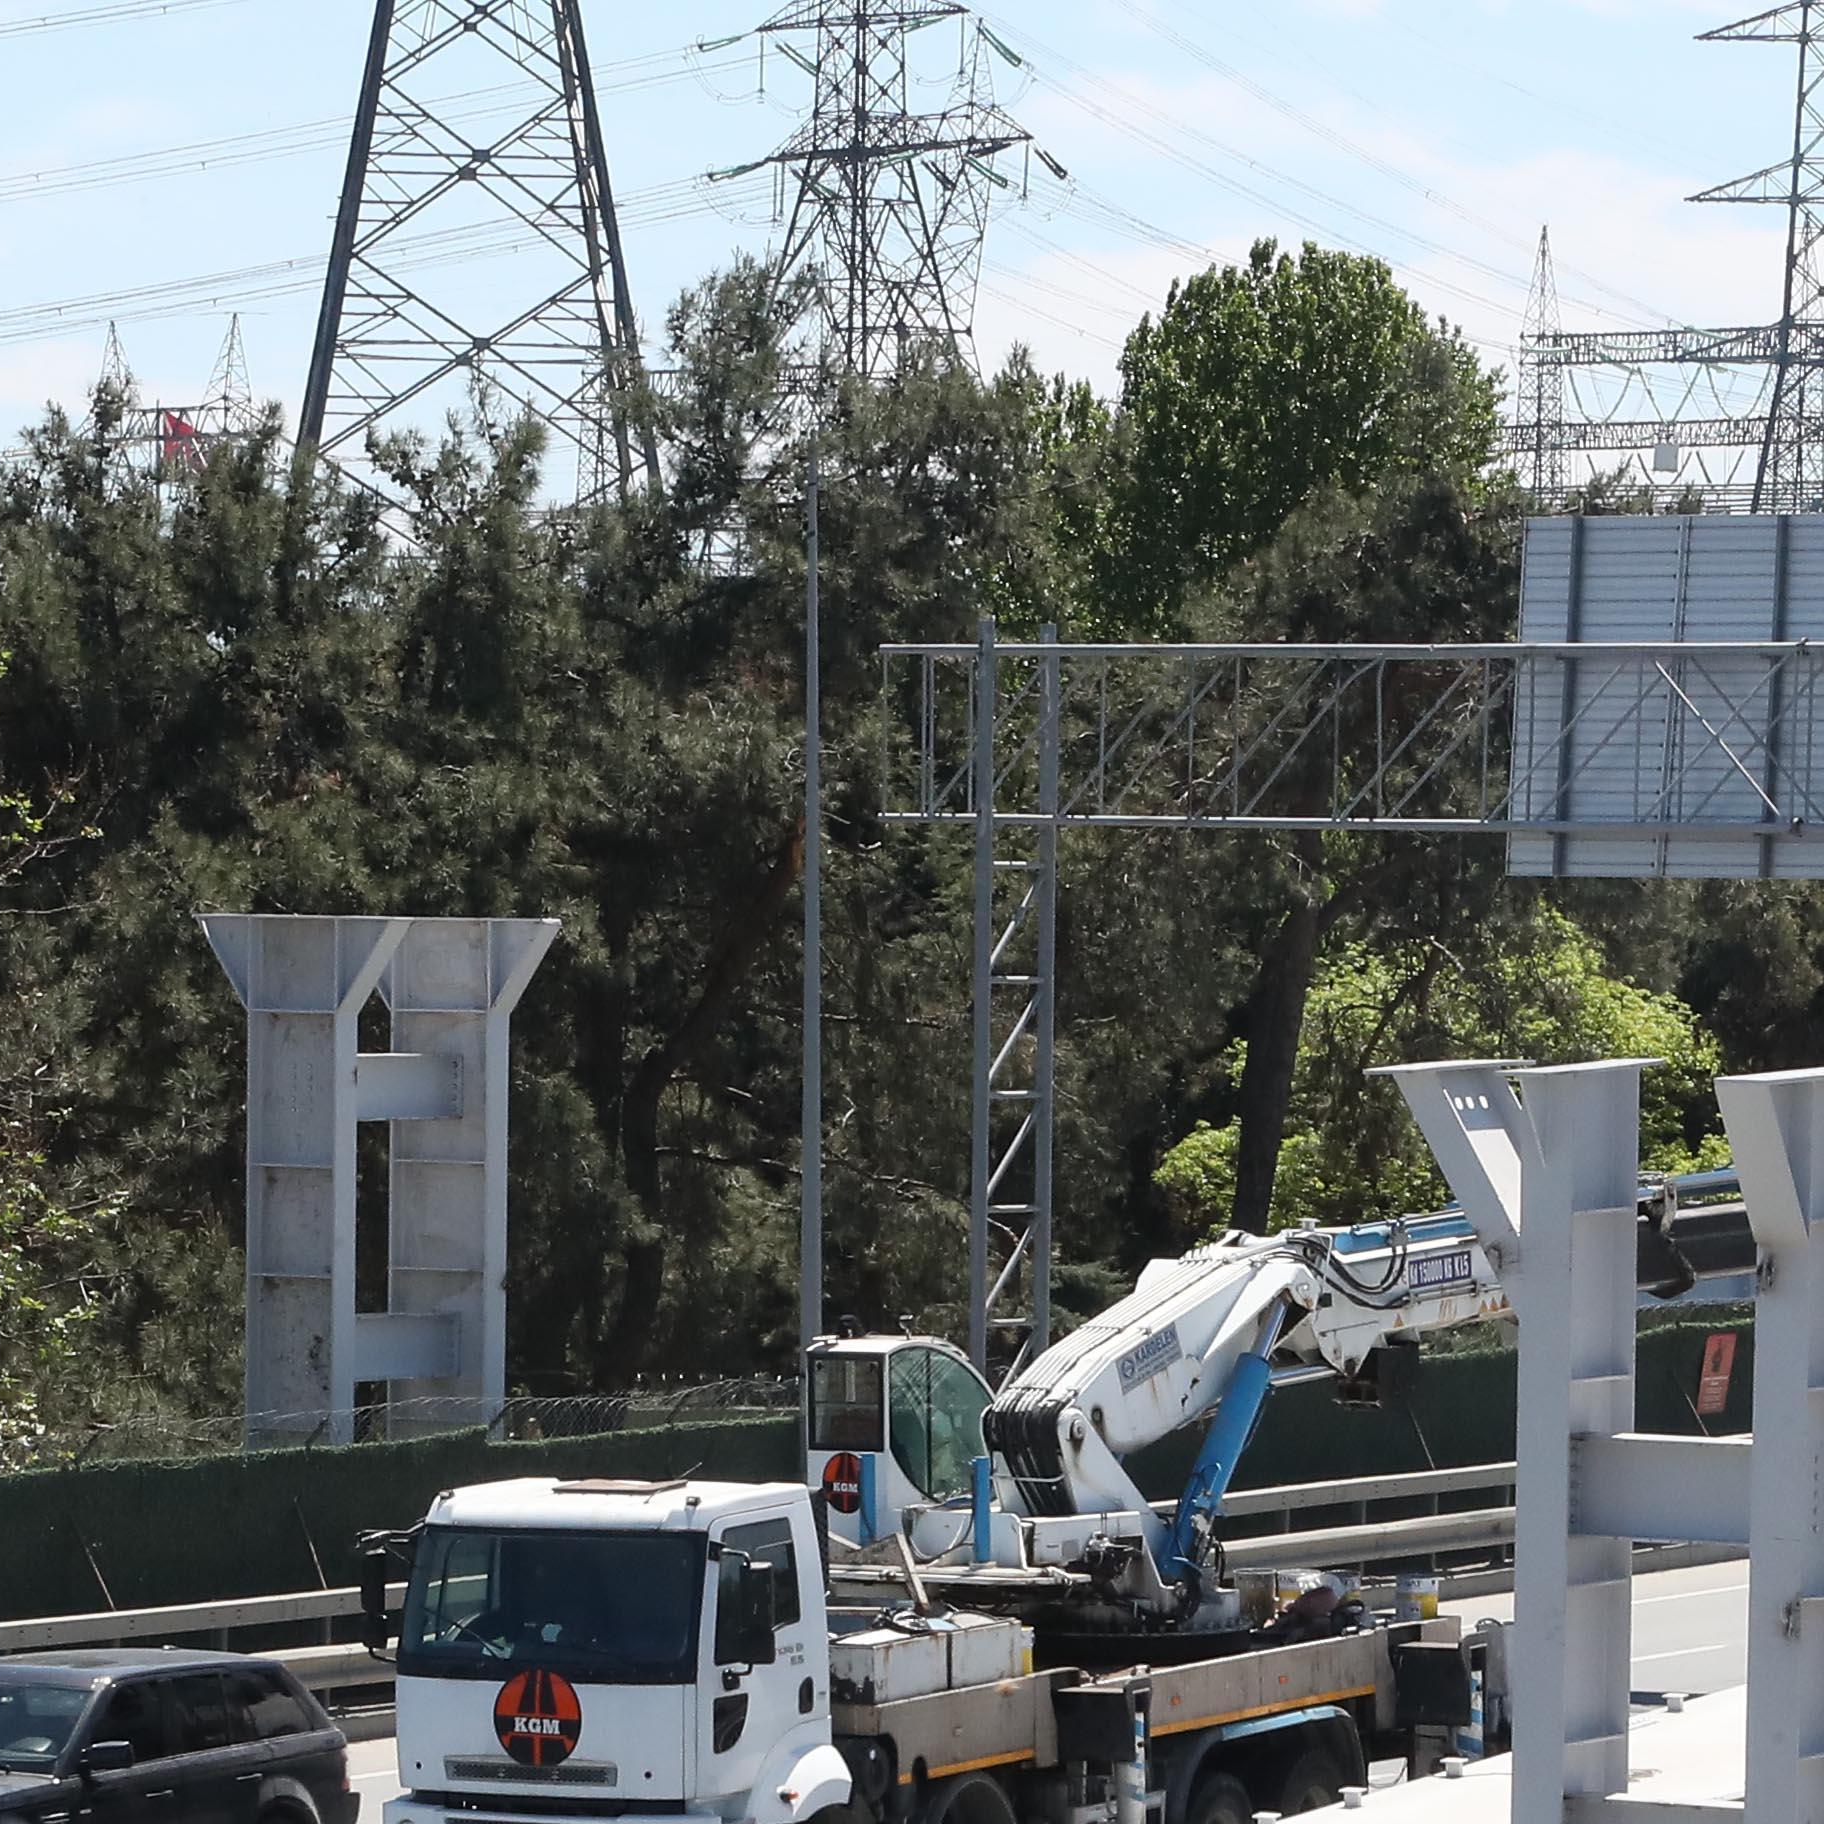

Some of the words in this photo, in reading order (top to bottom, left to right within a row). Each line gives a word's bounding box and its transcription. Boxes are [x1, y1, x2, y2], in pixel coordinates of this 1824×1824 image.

[1135, 1329, 1176, 1360] KARDELEN
[832, 1481, 859, 1493] KGM
[513, 1716, 561, 1735] KGM
